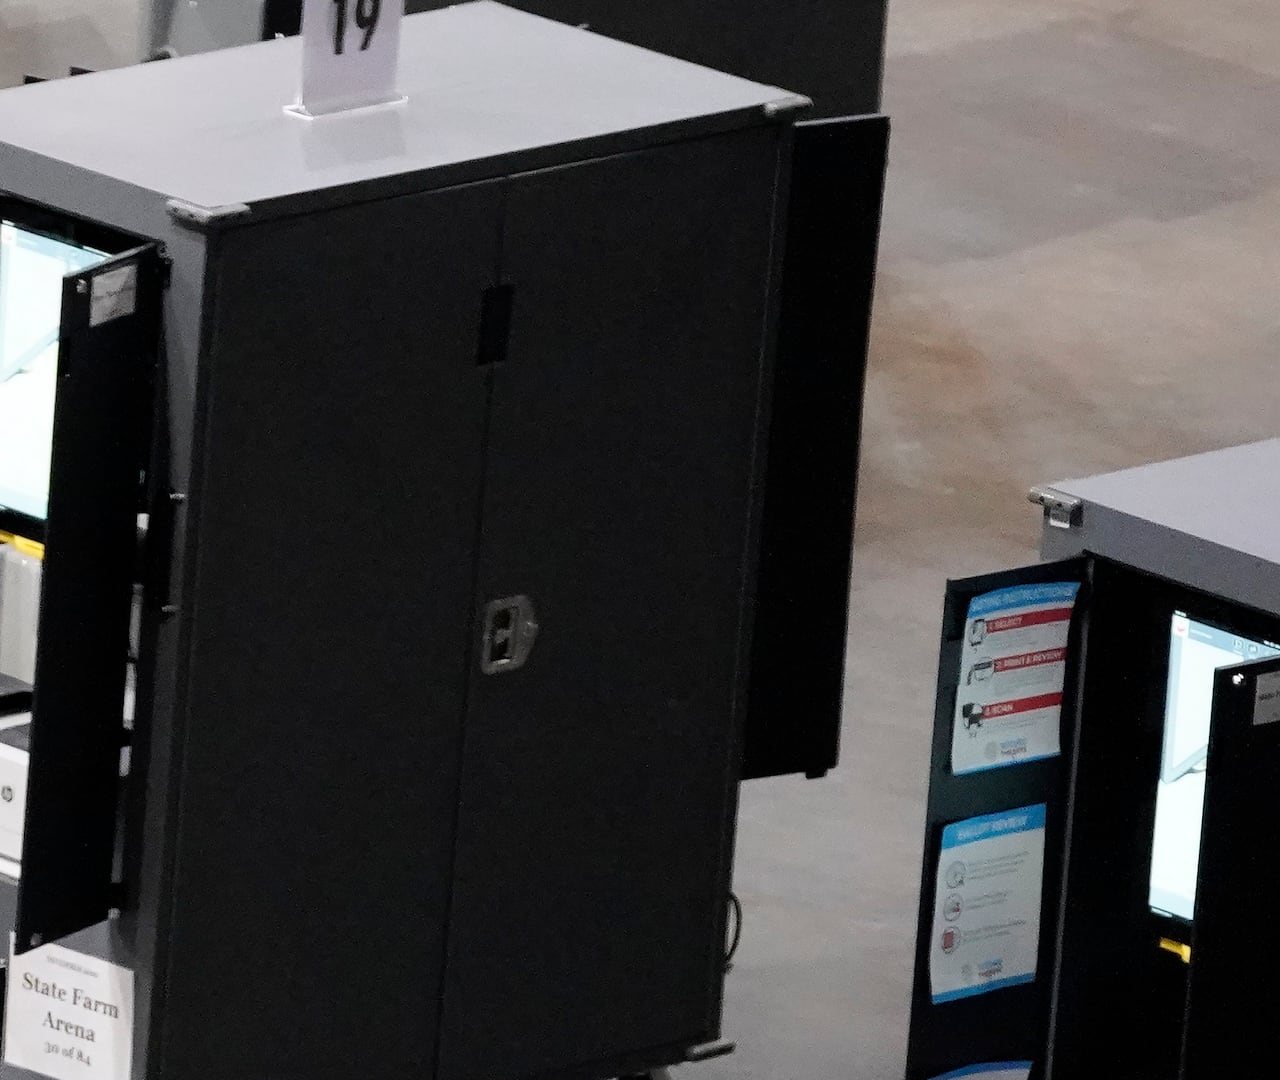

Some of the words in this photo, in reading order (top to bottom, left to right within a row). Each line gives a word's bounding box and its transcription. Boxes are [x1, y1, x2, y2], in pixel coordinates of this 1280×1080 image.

[22, 971, 67, 1001] State
[72, 987, 120, 1019] Farm
[42, 1010, 96, 1043] Arena
